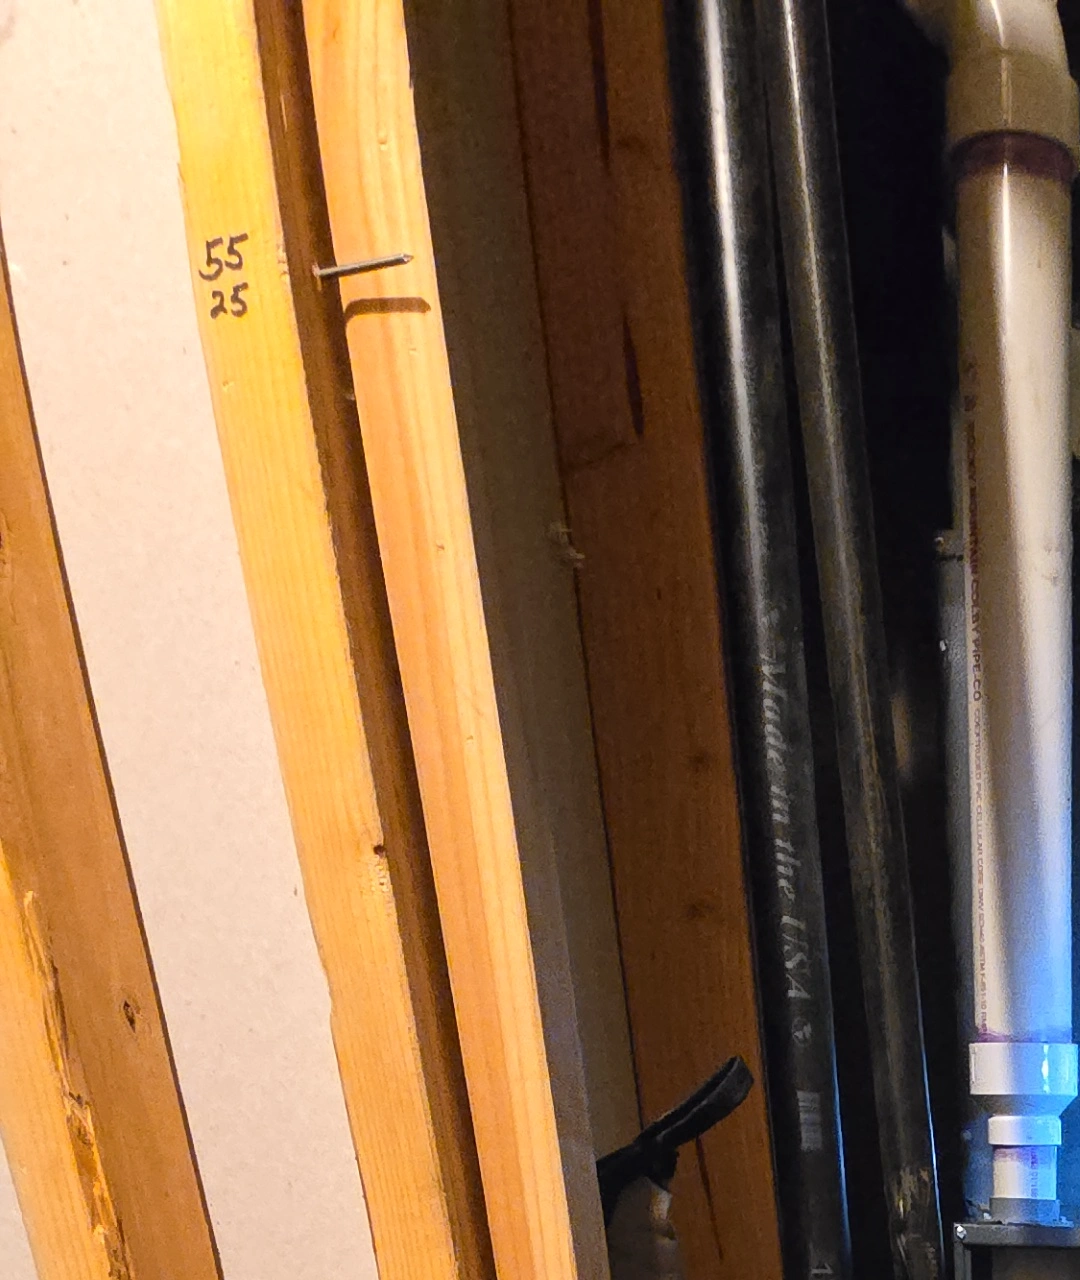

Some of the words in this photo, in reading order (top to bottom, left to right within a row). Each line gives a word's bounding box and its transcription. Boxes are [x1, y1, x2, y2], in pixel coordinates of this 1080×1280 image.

[198, 232, 249, 281] 55
[210, 282, 249, 319] 25
[970, 580, 981, 635] COLBY
[774, 838, 802, 900] the
[780, 914, 812, 998] USA
